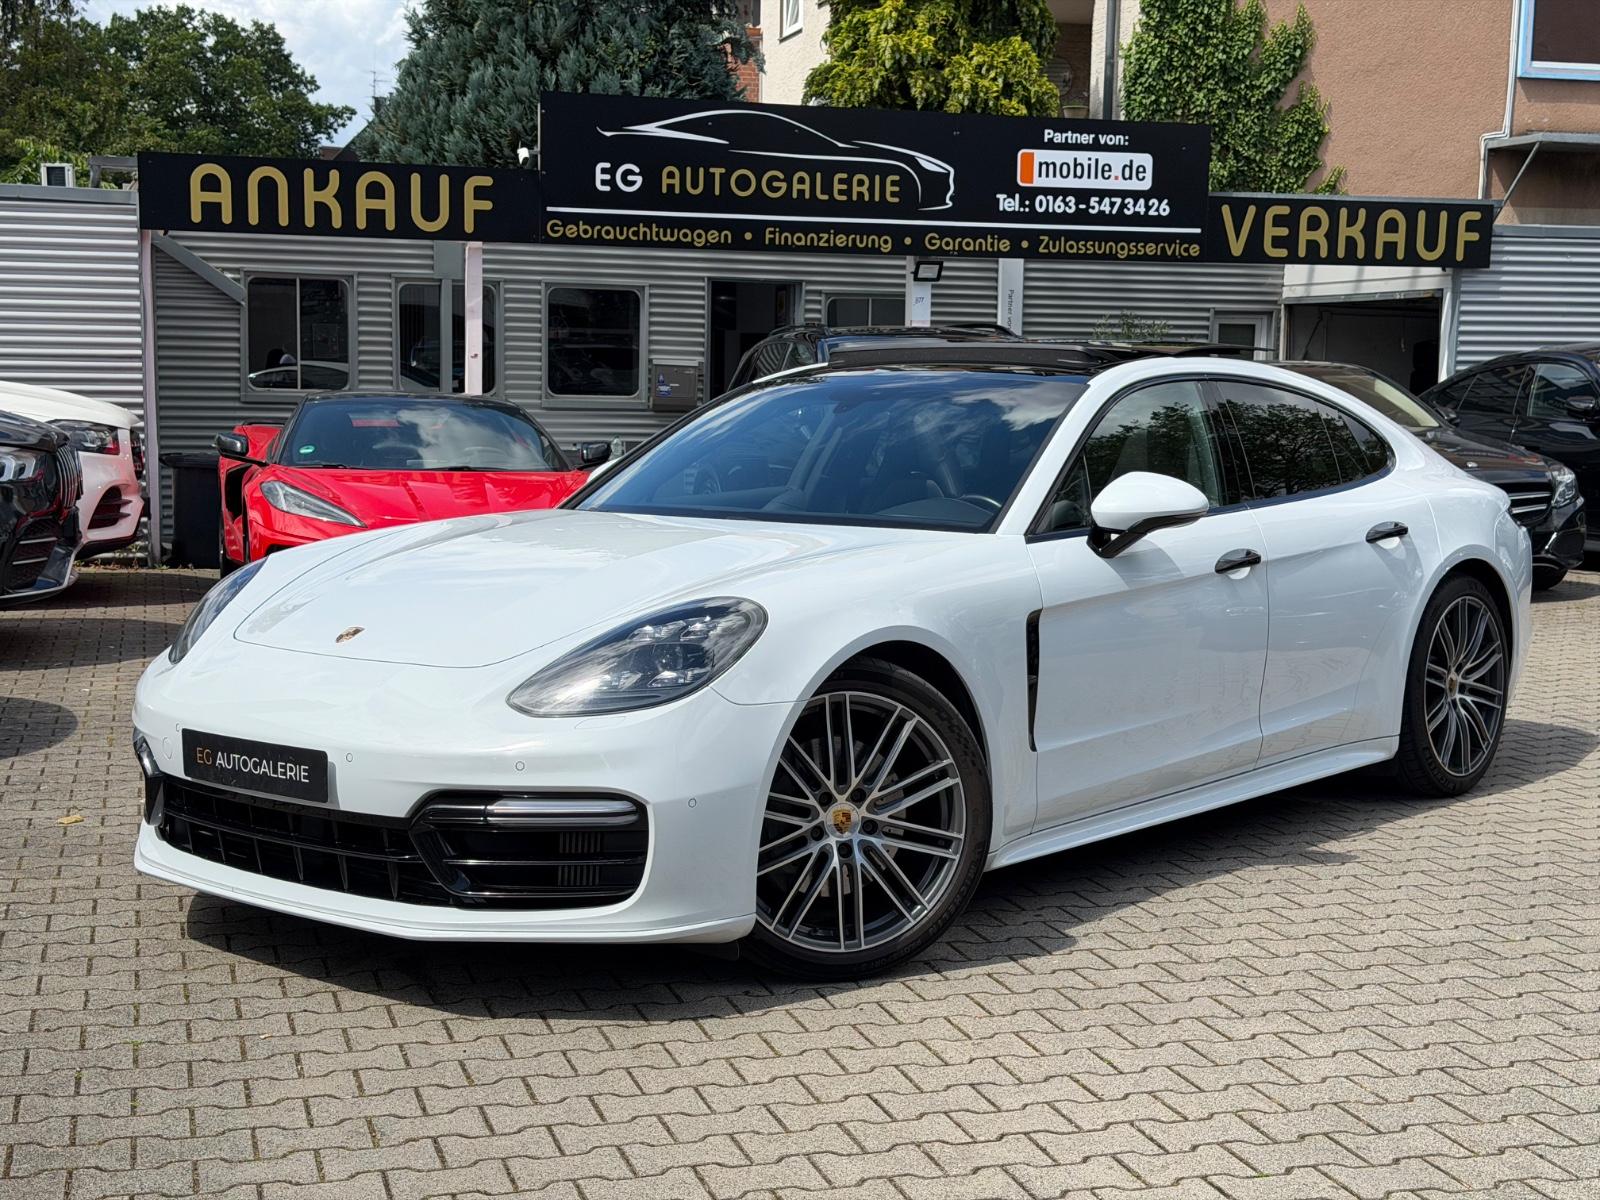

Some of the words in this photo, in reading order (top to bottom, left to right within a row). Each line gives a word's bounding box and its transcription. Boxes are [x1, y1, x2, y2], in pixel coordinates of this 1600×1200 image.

[1043, 129, 1094, 146] Partner
[1099, 131, 1129, 146] von:
[595, 162, 643, 193] EG
[661, 165, 901, 203] AUTOGALERIE
[1038, 157, 1147, 182] mobile.de
[190, 162, 494, 234] ANKAUF
[996, 193, 1030, 213] Tel.:
[546, 219, 732, 247] Gebrauchtwagen
[764, 227, 893, 253] Finanzierung
[924, 232, 1011, 253] Garantie
[1038, 235, 1200, 259] Zulassungsservice
[1221, 204, 1482, 262] VERKAUF
[1007, 289, 1015, 316] Partner
[196, 747, 213, 765] EG
[216, 751, 310, 783] AUTOGALERIE
